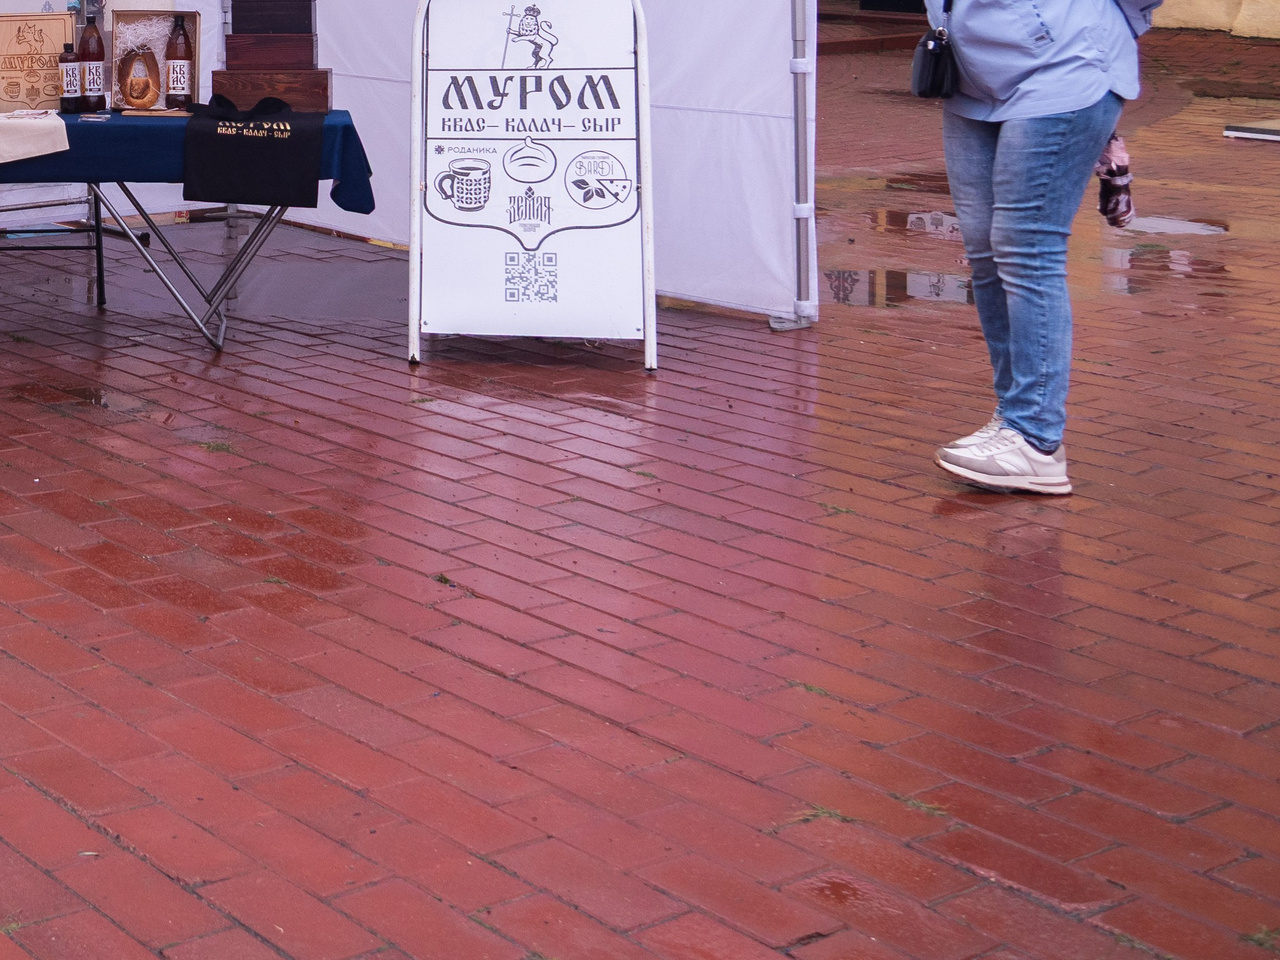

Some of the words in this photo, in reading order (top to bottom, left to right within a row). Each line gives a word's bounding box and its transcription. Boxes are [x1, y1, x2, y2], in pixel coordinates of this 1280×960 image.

[442, 75, 621, 110] МУРОМ
[582, 117, 621, 132] СЫР
[243, 128, 267, 137] КАЛАЧ
[447, 146, 497, 154] РОДАНИКА
